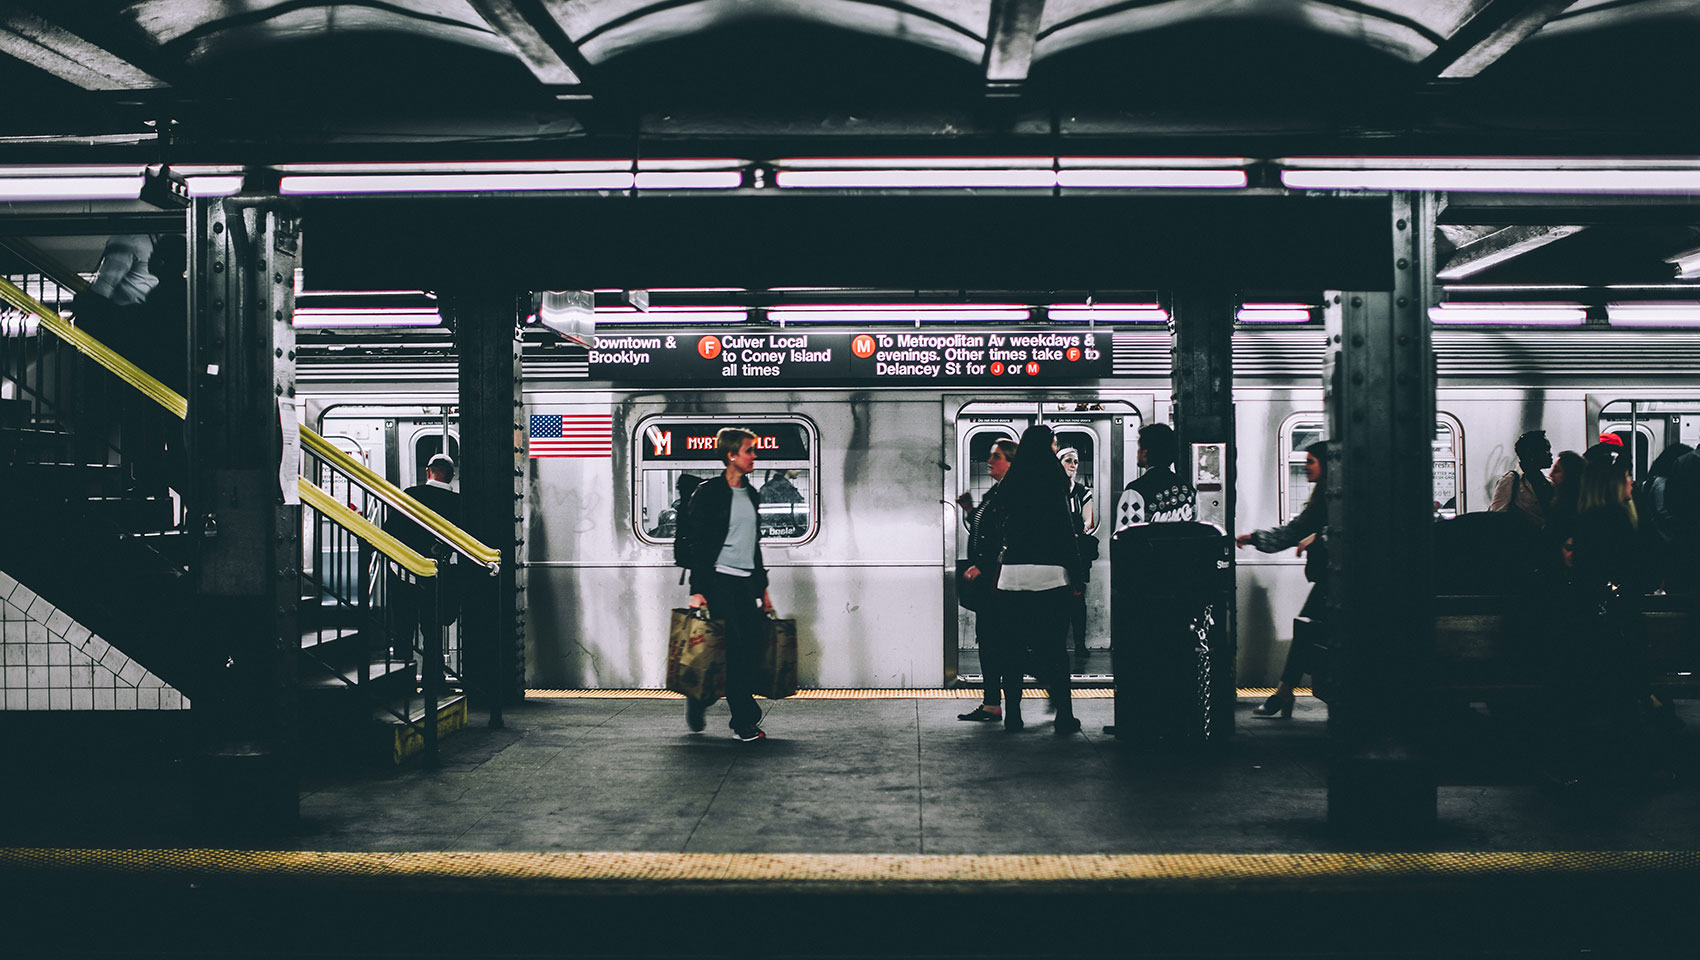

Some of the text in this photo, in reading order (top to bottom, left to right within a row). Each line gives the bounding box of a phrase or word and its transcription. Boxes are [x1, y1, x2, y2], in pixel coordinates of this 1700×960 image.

[665, 336, 677, 349] &
[721, 335, 808, 349] Culver Local
[875, 333, 1096, 350] To Metropolitan Av weekdays &
[588, 350, 650, 366] Brooklyn
[721, 349, 832, 366] to Coney Island
[875, 348, 941, 363] evenings.
[944, 347, 984, 361] Other
[988, 347, 1027, 361] times
[1031, 347, 1064, 361] take
[1084, 348, 1100, 361] to
[721, 363, 780, 377] all times
[876, 362, 941, 378] Delancey
[945, 362, 962, 376] St
[966, 362, 986, 376] for
[1007, 364, 1023, 376] or
[654, 429, 779, 456] M MYRT LCL
